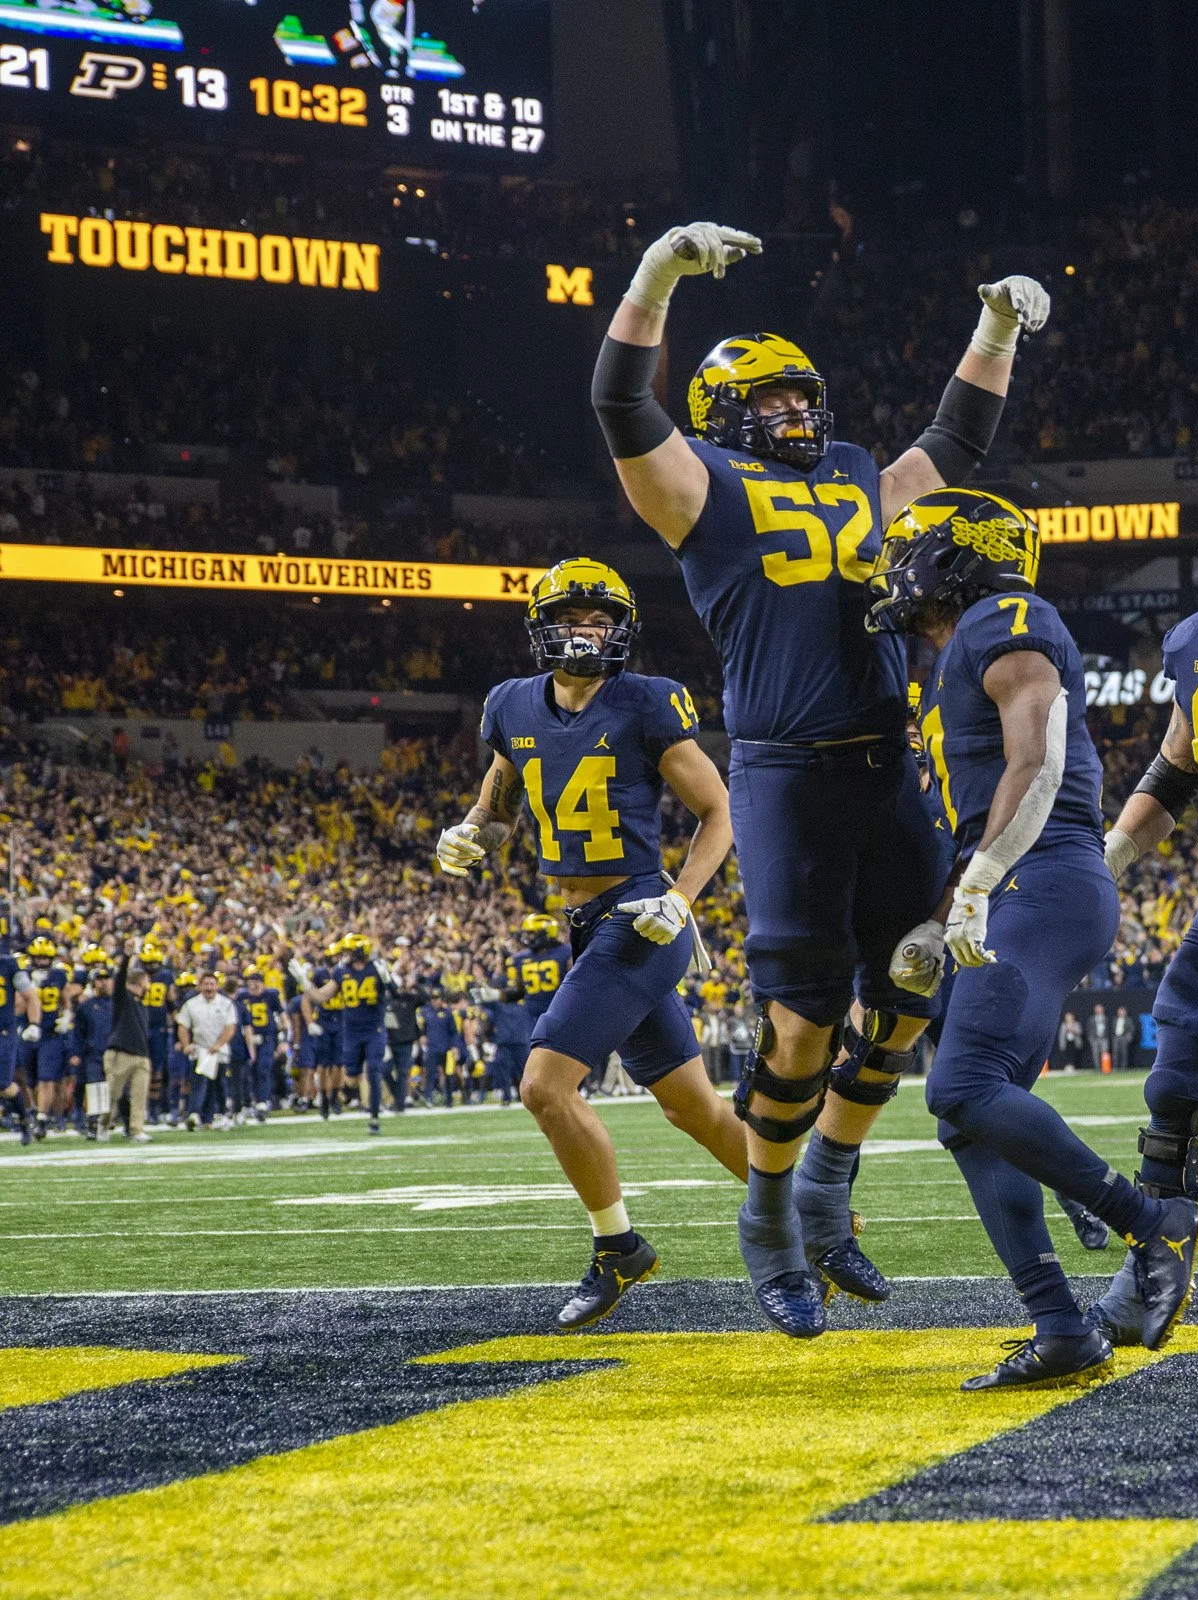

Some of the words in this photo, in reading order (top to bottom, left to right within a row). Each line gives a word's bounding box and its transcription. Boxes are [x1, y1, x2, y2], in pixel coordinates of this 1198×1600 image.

[0, 43, 49, 90] 21
[175, 65, 228, 111] 13
[249, 77, 368, 127] 10:32
[381, 84, 414, 104] QTR
[387, 105, 409, 135] 3
[438, 89, 478, 116] 1ST
[484, 92, 505, 119] &
[512, 97, 542, 124] 10
[431, 119, 462, 142] ON
[463, 122, 505, 147] THE
[511, 126, 545, 153] 27
[40, 213, 381, 292] TOUCHDOWN
[546, 264, 594, 305] M
[741, 477, 889, 587] 52
[102, 554, 245, 582] MICHIGAN
[258, 561, 431, 590] WOLVERINES
[501, 573, 529, 593] M
[998, 598, 1028, 635] 7
[670, 687, 698, 730] 14
[522, 756, 624, 862] 14
[342, 976, 378, 1008] 84
[521, 959, 560, 994] 53
